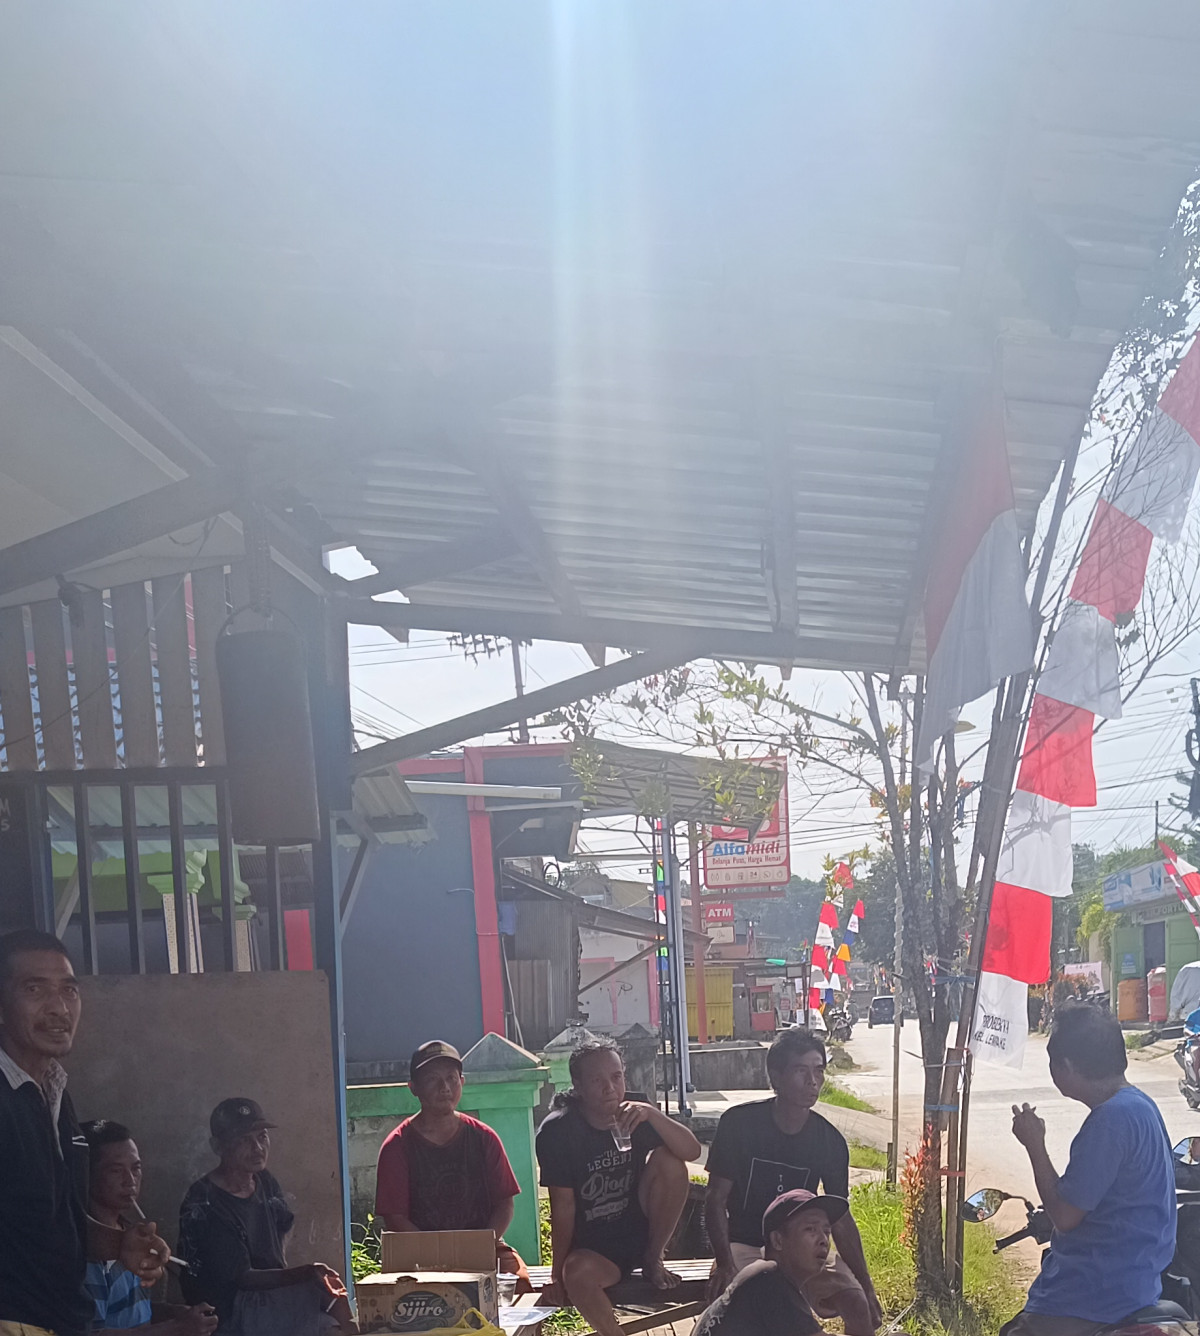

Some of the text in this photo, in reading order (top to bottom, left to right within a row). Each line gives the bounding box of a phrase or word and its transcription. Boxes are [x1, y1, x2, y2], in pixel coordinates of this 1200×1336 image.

[712, 841, 780, 856] Alfamidi
[712, 857, 731, 866] Belanja
[747, 856, 763, 864] Harga
[707, 908, 732, 918] ATM
[391, 1301, 443, 1324] Sijiro
